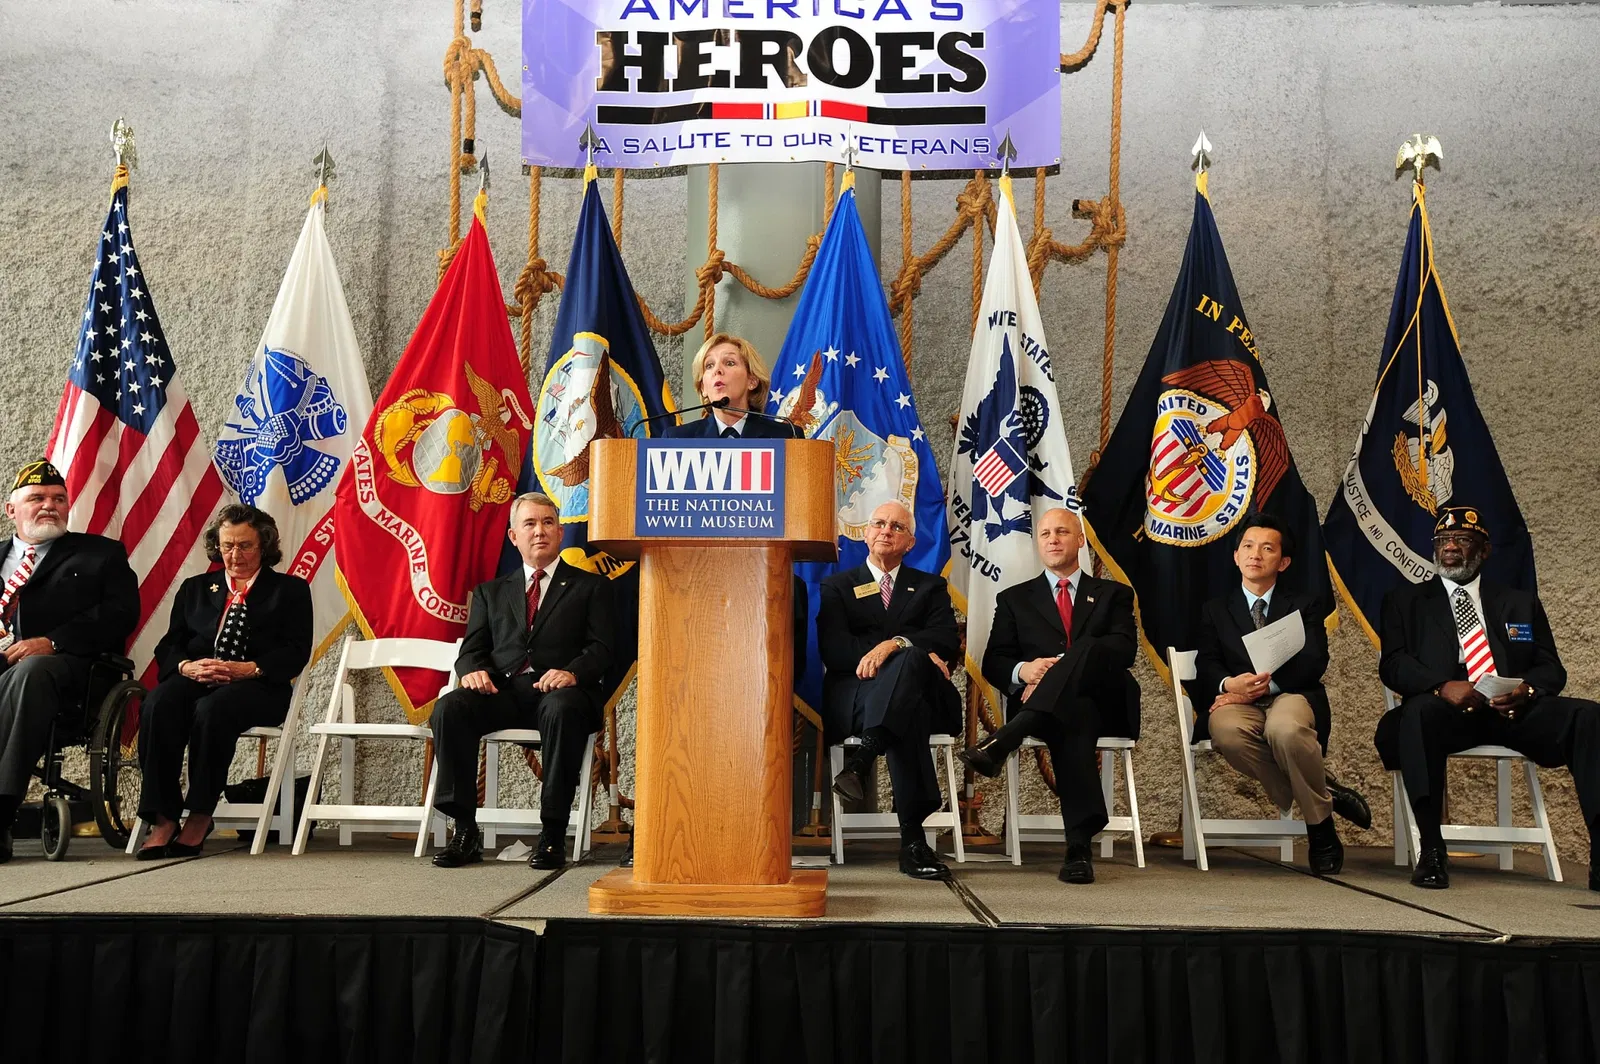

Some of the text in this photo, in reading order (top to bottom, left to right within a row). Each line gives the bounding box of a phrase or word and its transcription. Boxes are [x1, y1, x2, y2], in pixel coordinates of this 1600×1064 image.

[619, 0, 964, 21] AMERICAS
[596, 26, 988, 93] HEROES
[593, 131, 990, 155] A SALUTE TO OUR ETERANS
[1195, 293, 1263, 364] IN PEA
[646, 448, 775, 494] WWII
[899, 450, 917, 484] FORCE
[645, 498, 775, 512] THE NATIONAL
[1215, 454, 1251, 527] STATES
[1346, 472, 1372, 522] JUSTICE
[1368, 524, 1384, 541] AND
[645, 515, 775, 529] WWII MUSEUM
[1150, 518, 1209, 541] MARINE
[374, 507, 426, 574] MARINE
[418, 586, 468, 622] CORPS
